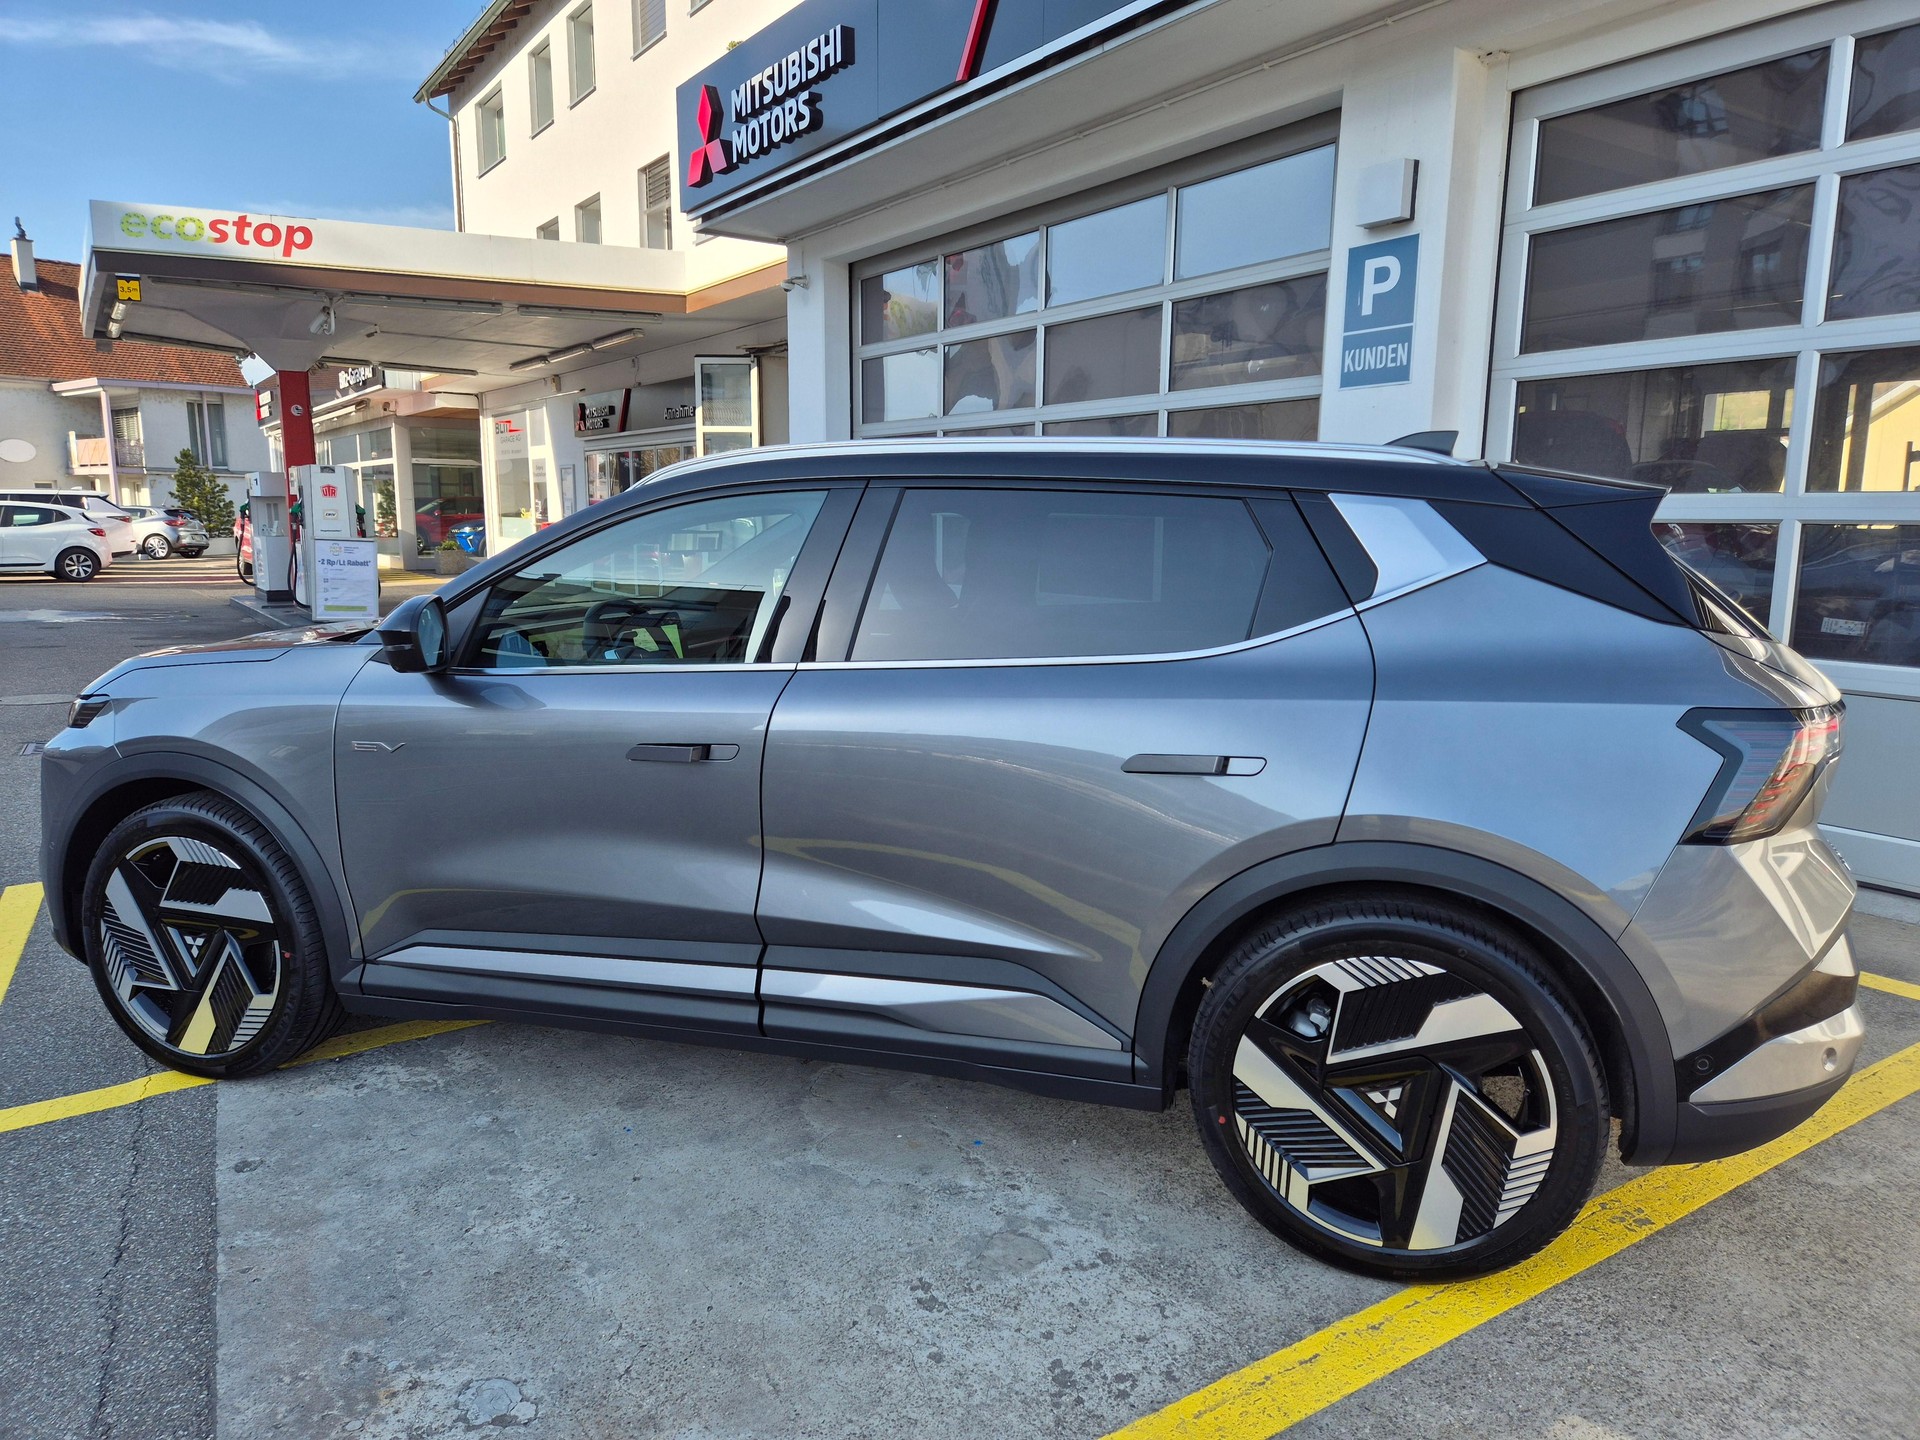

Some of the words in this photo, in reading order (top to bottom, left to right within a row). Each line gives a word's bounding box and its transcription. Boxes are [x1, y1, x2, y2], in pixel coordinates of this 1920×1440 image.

[731, 24, 843, 123] MITSUBISHI
[731, 91, 811, 164] MOTORS
[120, 211, 314, 258] ecostop
[1361, 255, 1402, 316] P
[1344, 342, 1409, 373] KUNDEN
[585, 419, 604, 430] MOTORS
[663, 404, 694, 420] Annahme
